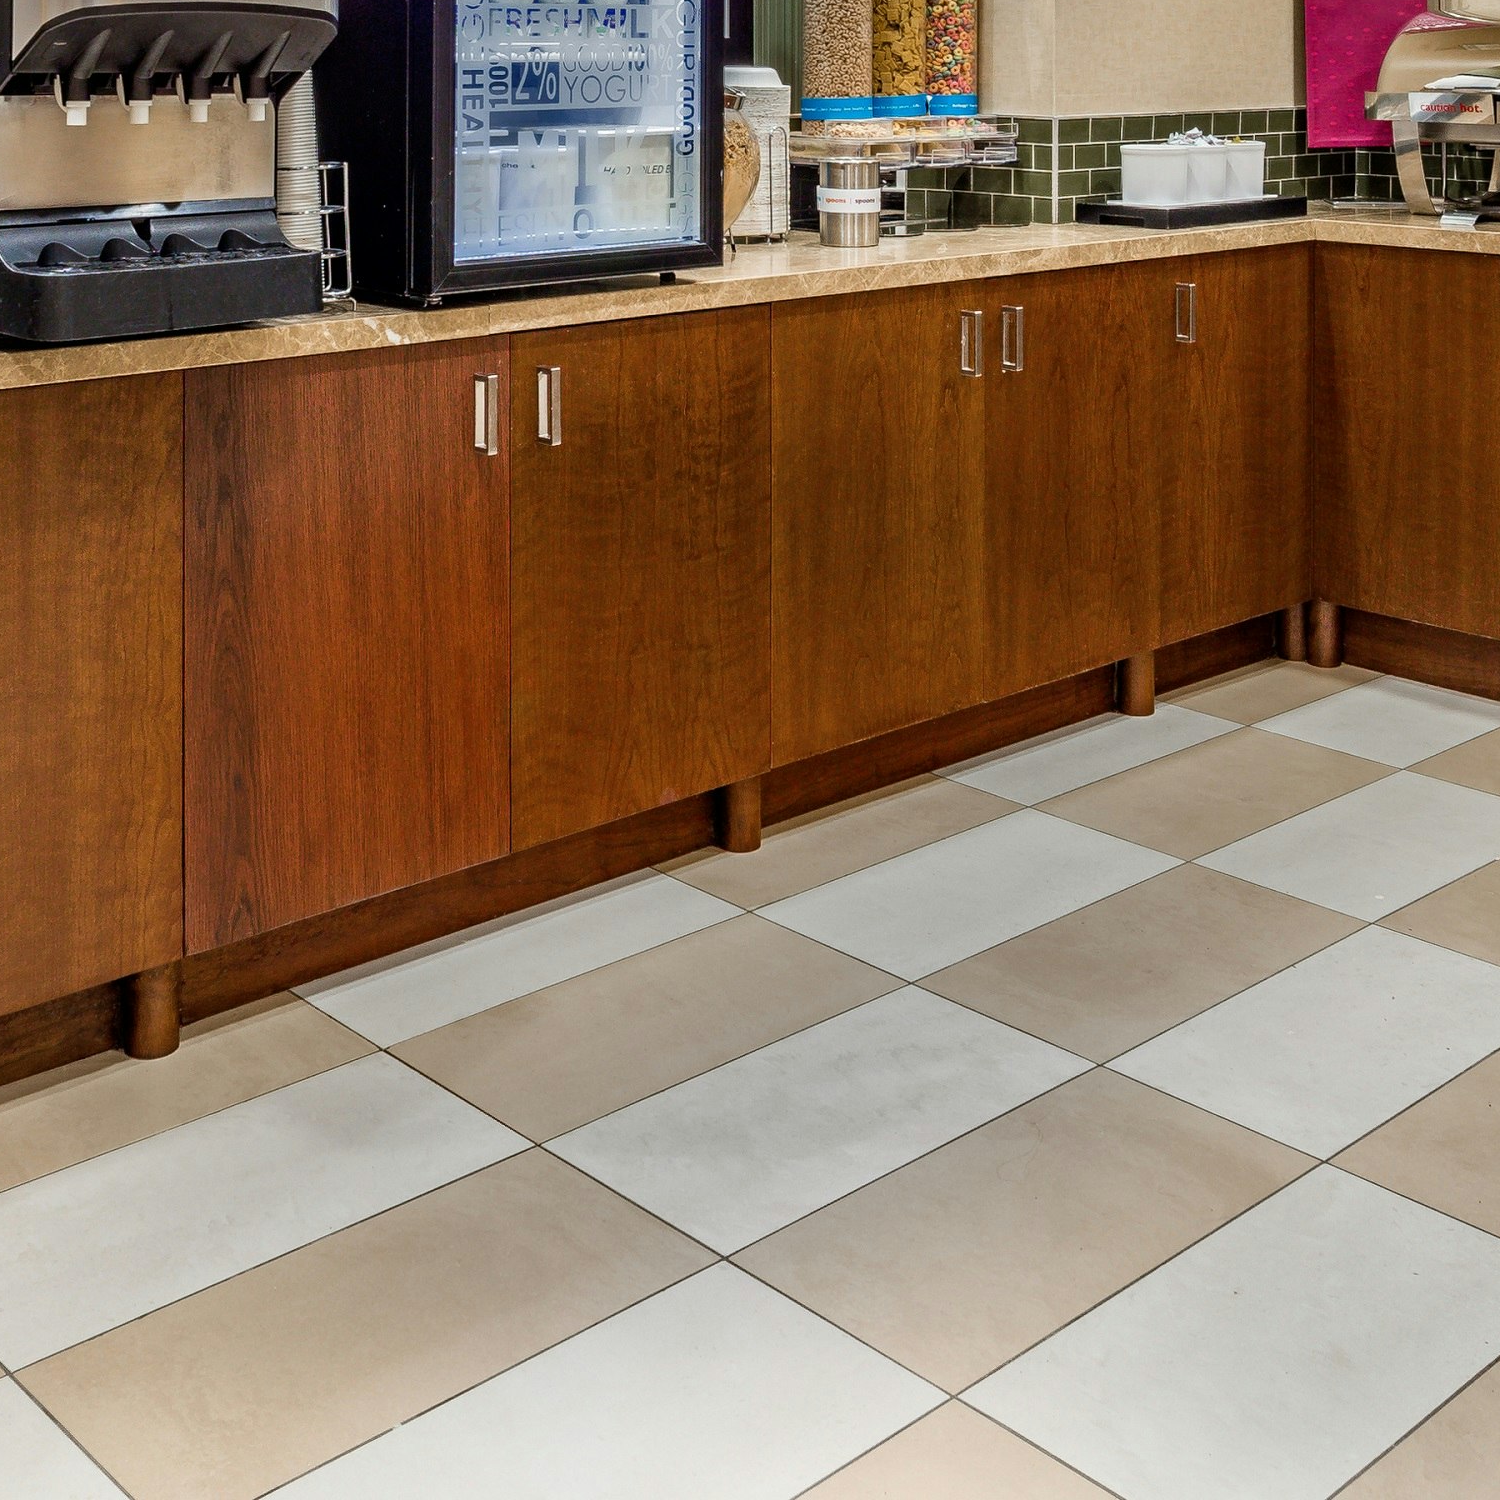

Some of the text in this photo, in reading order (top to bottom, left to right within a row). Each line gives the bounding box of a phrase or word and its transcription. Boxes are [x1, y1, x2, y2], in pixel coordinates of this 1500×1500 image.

[489, 7, 676, 40] FRESH MILK
[515, 46, 557, 101] 2%
[562, 43, 674, 74] GOOD 100%
[563, 74, 673, 105] YOGURT
[675, 85, 695, 156] GOOD
[1420, 103, 1483, 113] caution hot.
[461, 68, 486, 214] HEALTHY
[825, 197, 847, 205] spoons
